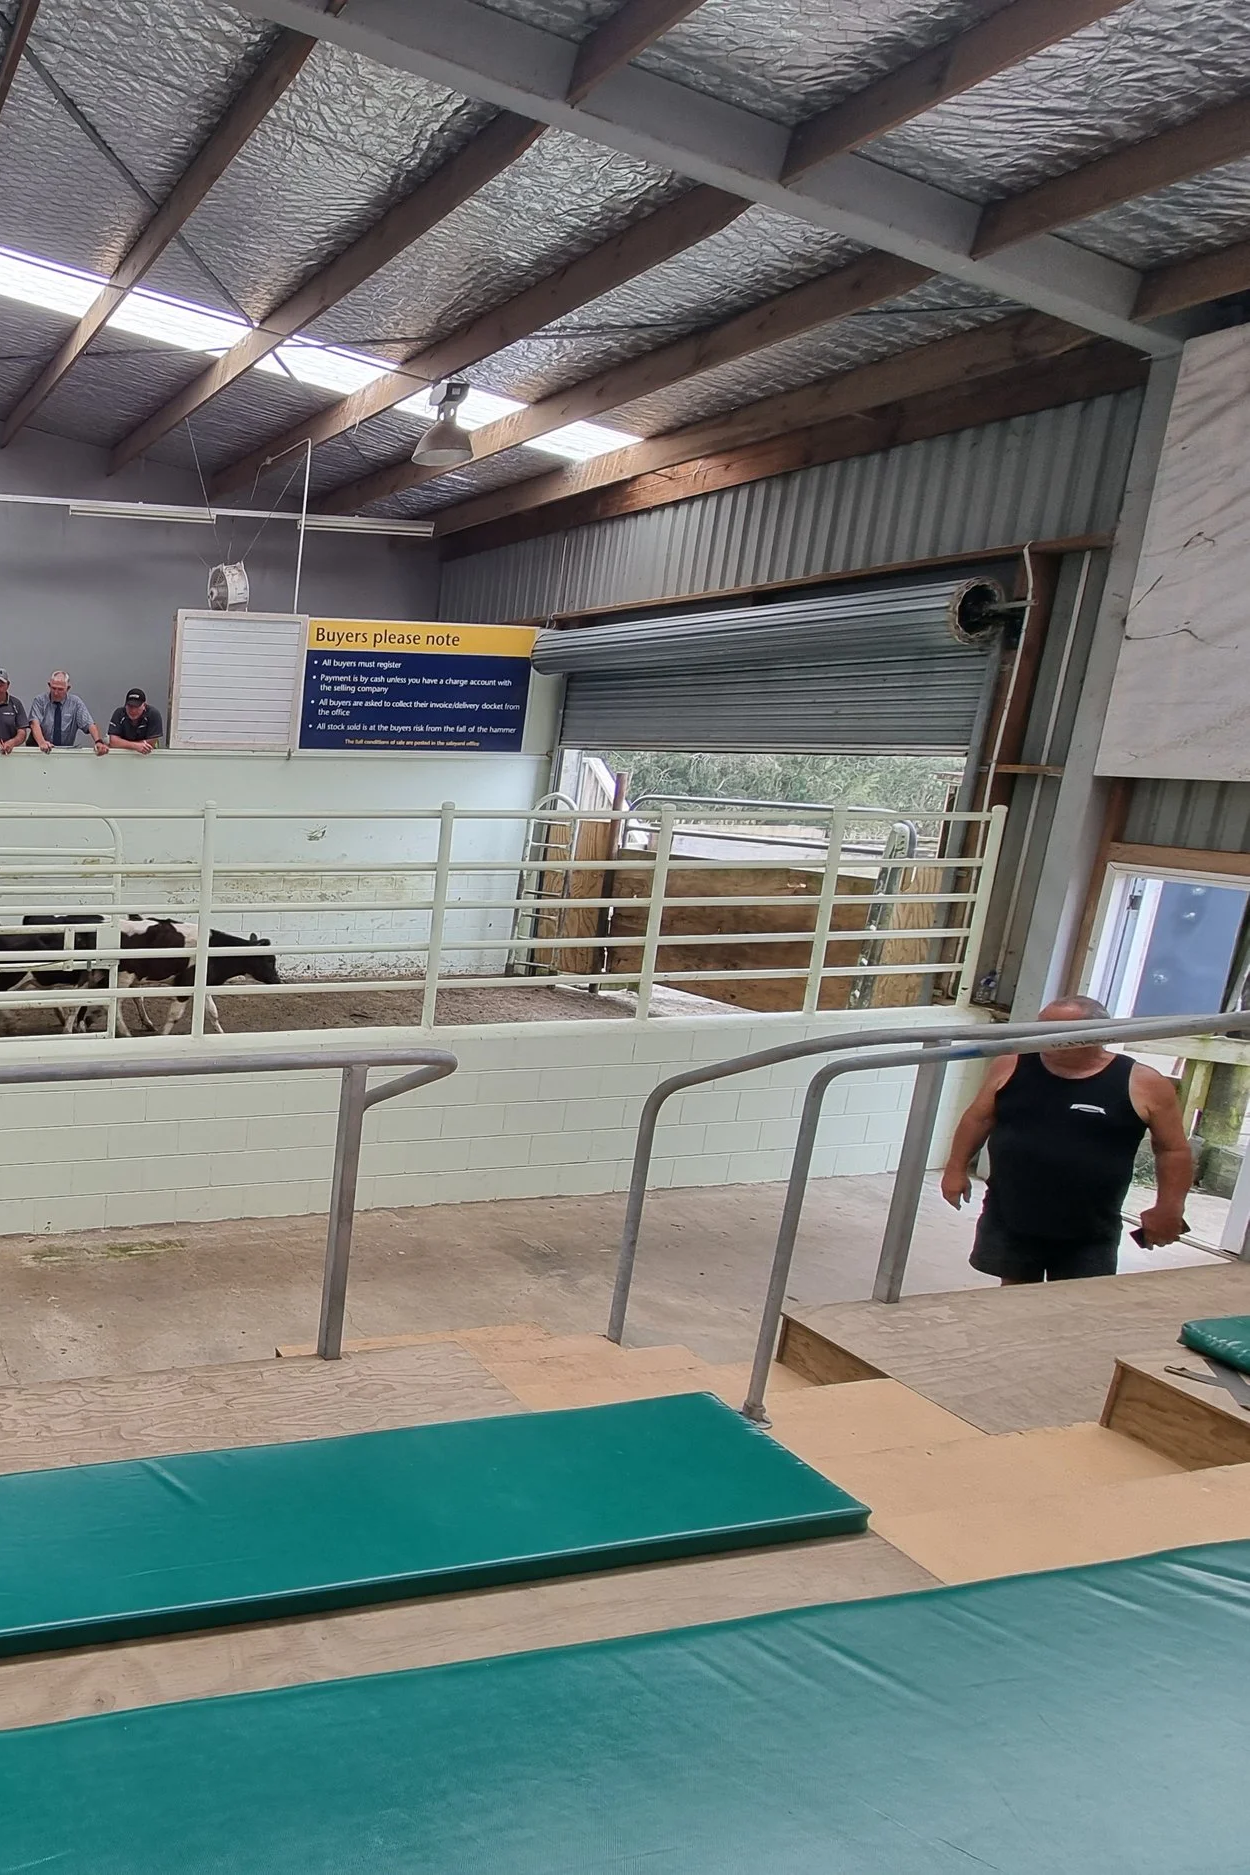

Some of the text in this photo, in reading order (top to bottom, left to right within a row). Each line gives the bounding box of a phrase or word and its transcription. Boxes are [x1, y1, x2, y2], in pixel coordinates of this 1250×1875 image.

[316, 627, 460, 648] Buyers please note
[322, 659, 332, 667] All
[333, 659, 356, 669] buyers
[377, 661, 402, 670] register
[320, 674, 351, 683] Payment
[353, 674, 358, 682] is
[359, 674, 369, 684] by
[370, 675, 385, 683] cash
[386, 676, 407, 684] unless
[408, 678, 421, 686] you
[422, 676, 438, 684] have
[445, 677, 468, 687] charge
[469, 678, 496, 687] account
[497, 678, 512, 687] with
[320, 684, 389, 695] the selling company
[318, 698, 329, 706] All
[329, 698, 352, 708] buyers
[364, 700, 383, 708] asked
[383, 700, 391, 708] to
[391, 700, 413, 708] collect
[430, 701, 480, 711] invoice/delivery
[481, 702, 504, 711] docket
[504, 702, 520, 711] from
[318, 708, 350, 716] the office
[316, 722, 517, 734] All stock sold is at the buyers risk from the fall of the hammer
